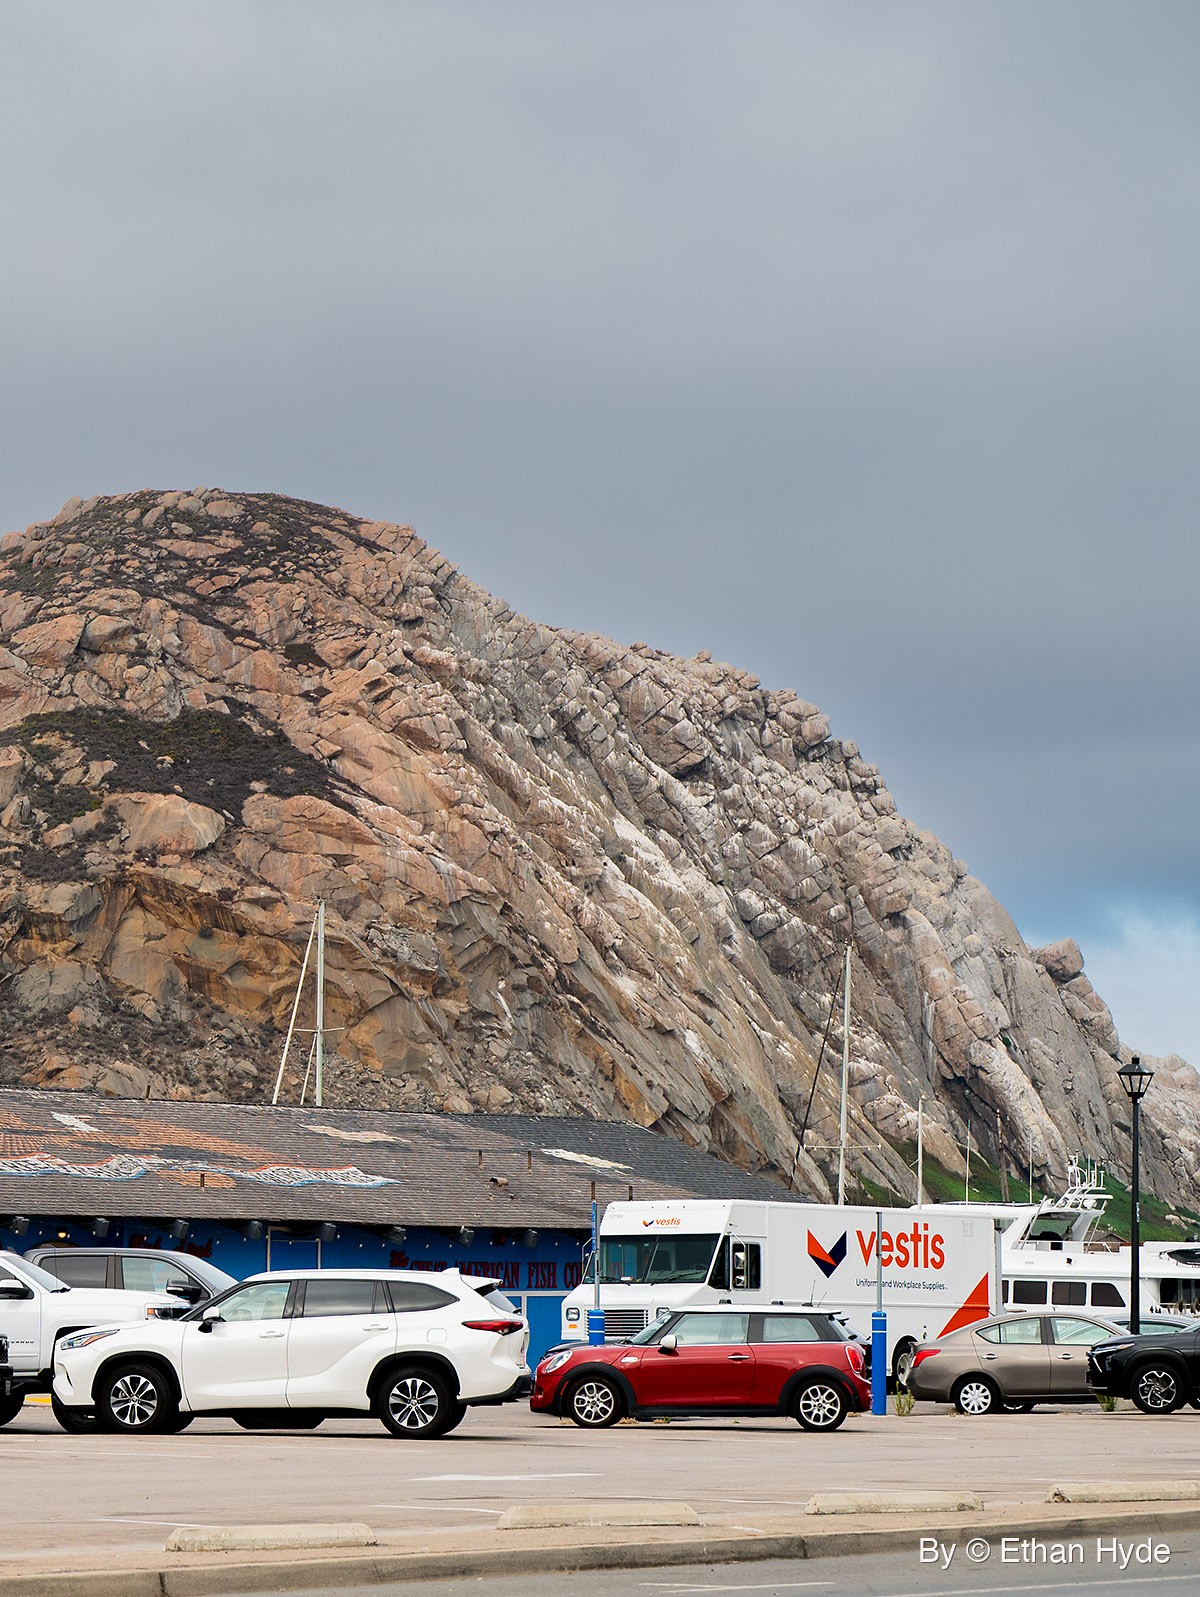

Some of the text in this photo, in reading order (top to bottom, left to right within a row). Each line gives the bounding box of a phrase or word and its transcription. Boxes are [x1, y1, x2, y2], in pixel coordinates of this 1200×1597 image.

[655, 1217, 681, 1226] vestis
[855, 1222, 945, 1270] vestis
[527, 1261, 558, 1290] FISH
[855, 1278, 879, 1288] Uniform
[893, 1279, 922, 1291] Workplace
